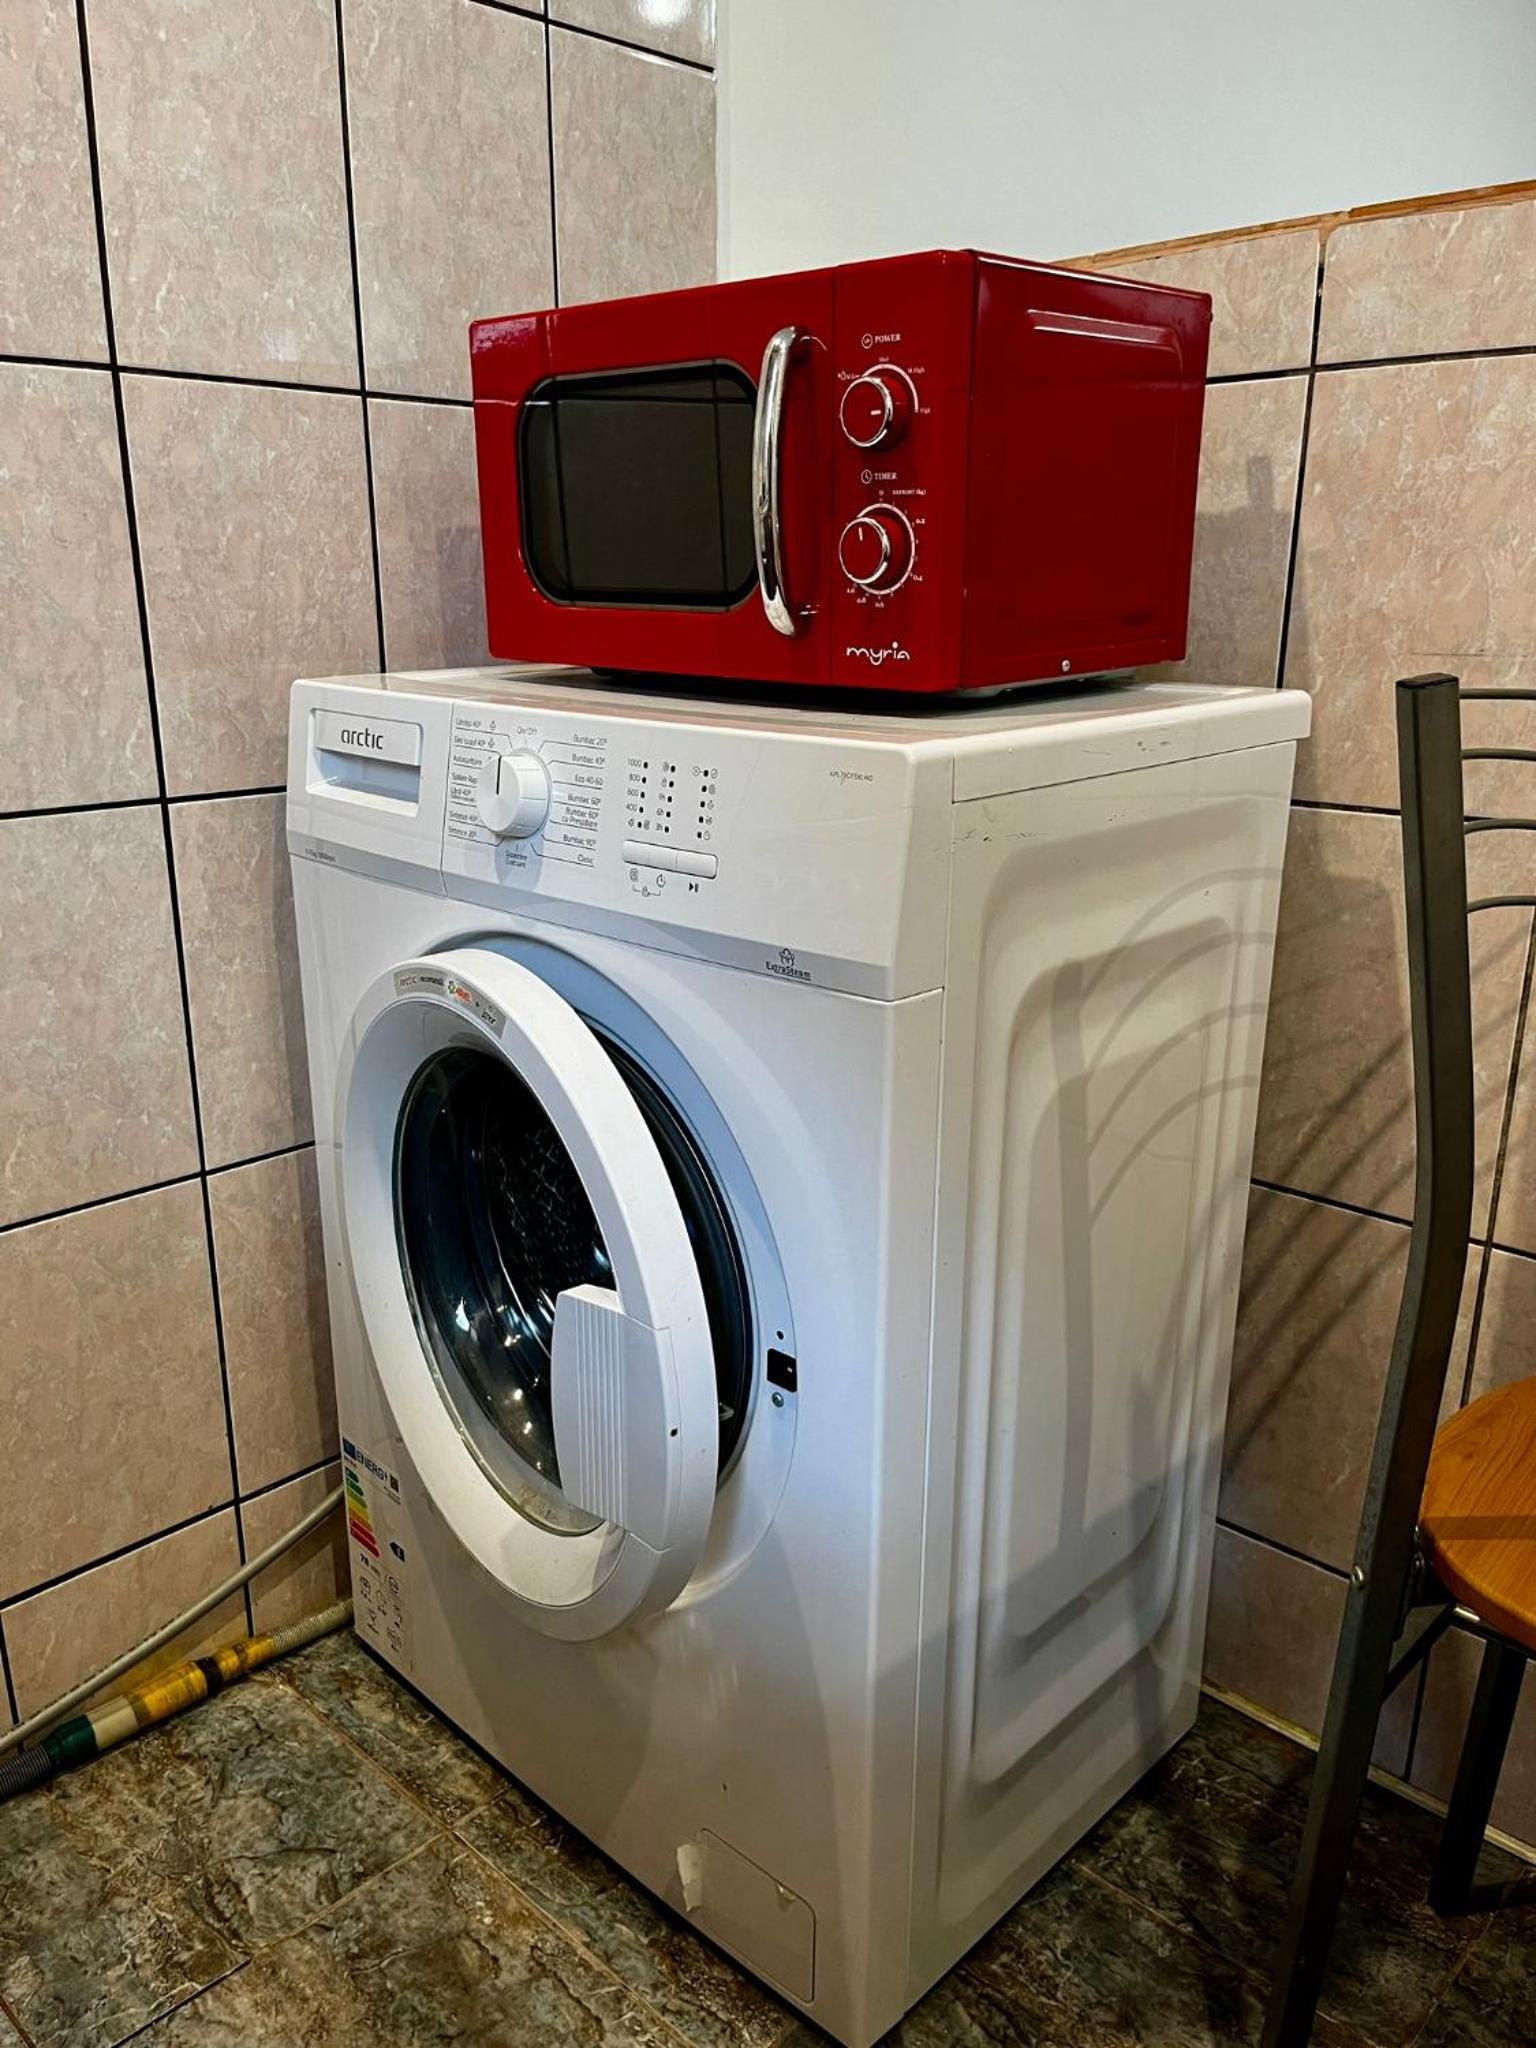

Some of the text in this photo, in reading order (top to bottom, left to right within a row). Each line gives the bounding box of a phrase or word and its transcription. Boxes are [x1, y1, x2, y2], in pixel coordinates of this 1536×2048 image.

[874, 333, 901, 344] POWER
[874, 472, 898, 481] TIMER
[846, 641, 911, 665] myria
[341, 727, 384, 750] arctic
[628, 758, 642, 768] 1000
[629, 773, 640, 782] 800
[627, 788, 639, 797] 600
[626, 803, 638, 812] 400
